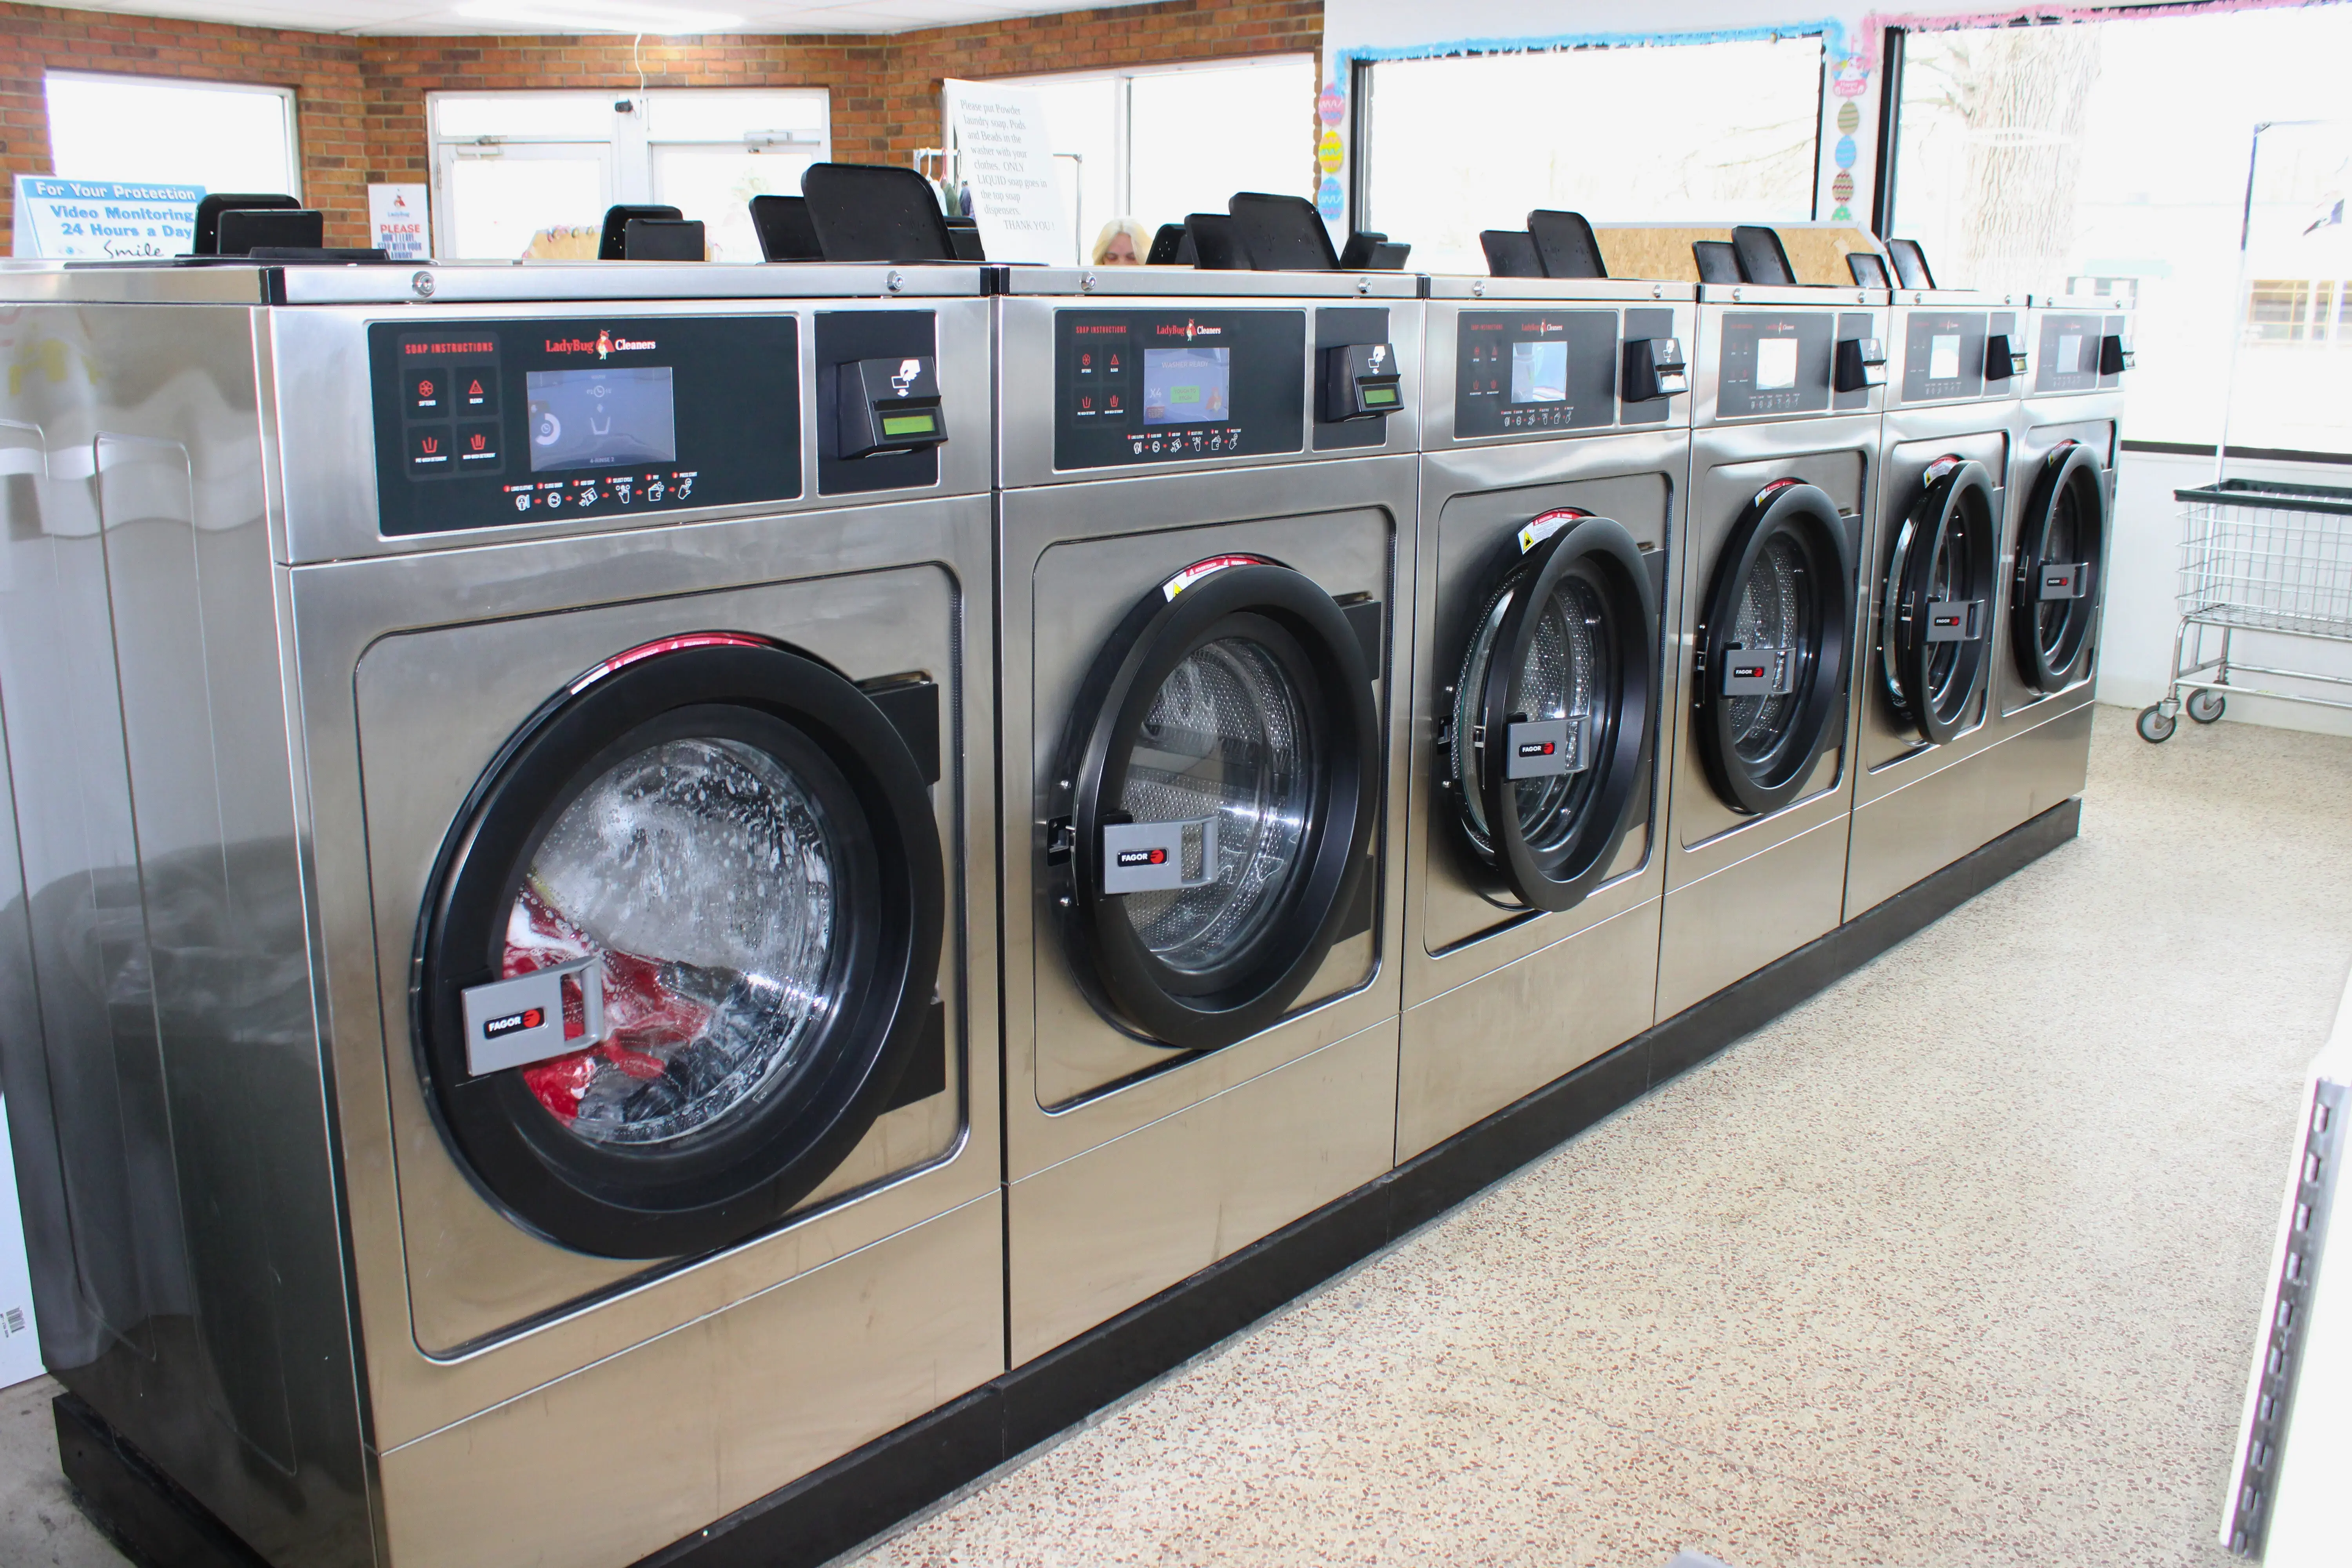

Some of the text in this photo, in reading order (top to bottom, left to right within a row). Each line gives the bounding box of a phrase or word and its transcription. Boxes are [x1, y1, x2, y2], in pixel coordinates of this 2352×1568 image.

[960, 99, 1020, 115] Please put Powder
[963, 114, 1026, 131] laundry soap, Pods
[968, 130, 1021, 143] and Beads in the
[971, 145, 1027, 160] washer with your
[974, 159, 1024, 172] clothes. ONLY
[977, 174, 1047, 189] LIQUID soap goes in
[35, 181, 196, 200] For Your Protection
[981, 189, 1020, 203] the top soap
[50, 205, 195, 223] Video Monitoring
[984, 204, 1021, 216] dispensers.
[61, 223, 192, 240] 24 Hours a Day
[380, 224, 421, 233] PLEASE
[1004, 220, 1032, 230] THANK
[1033, 221, 1050, 230] YOU
[104, 240, 164, 259] Smile
[1156, 324, 1221, 336] LadyBug Cleaners
[405, 342, 494, 354] SOAP INSTRUCTIONS
[545, 339, 656, 354] LadyBug Cleaners
[1150, 387, 1162, 398] X4
[1195, 562, 1217, 573] ADVERTENCIA
[623, 648, 659, 665] ADVERTENCIA
[1121, 852, 1148, 862] FAGOR
[488, 1016, 521, 1032] FAGOR
